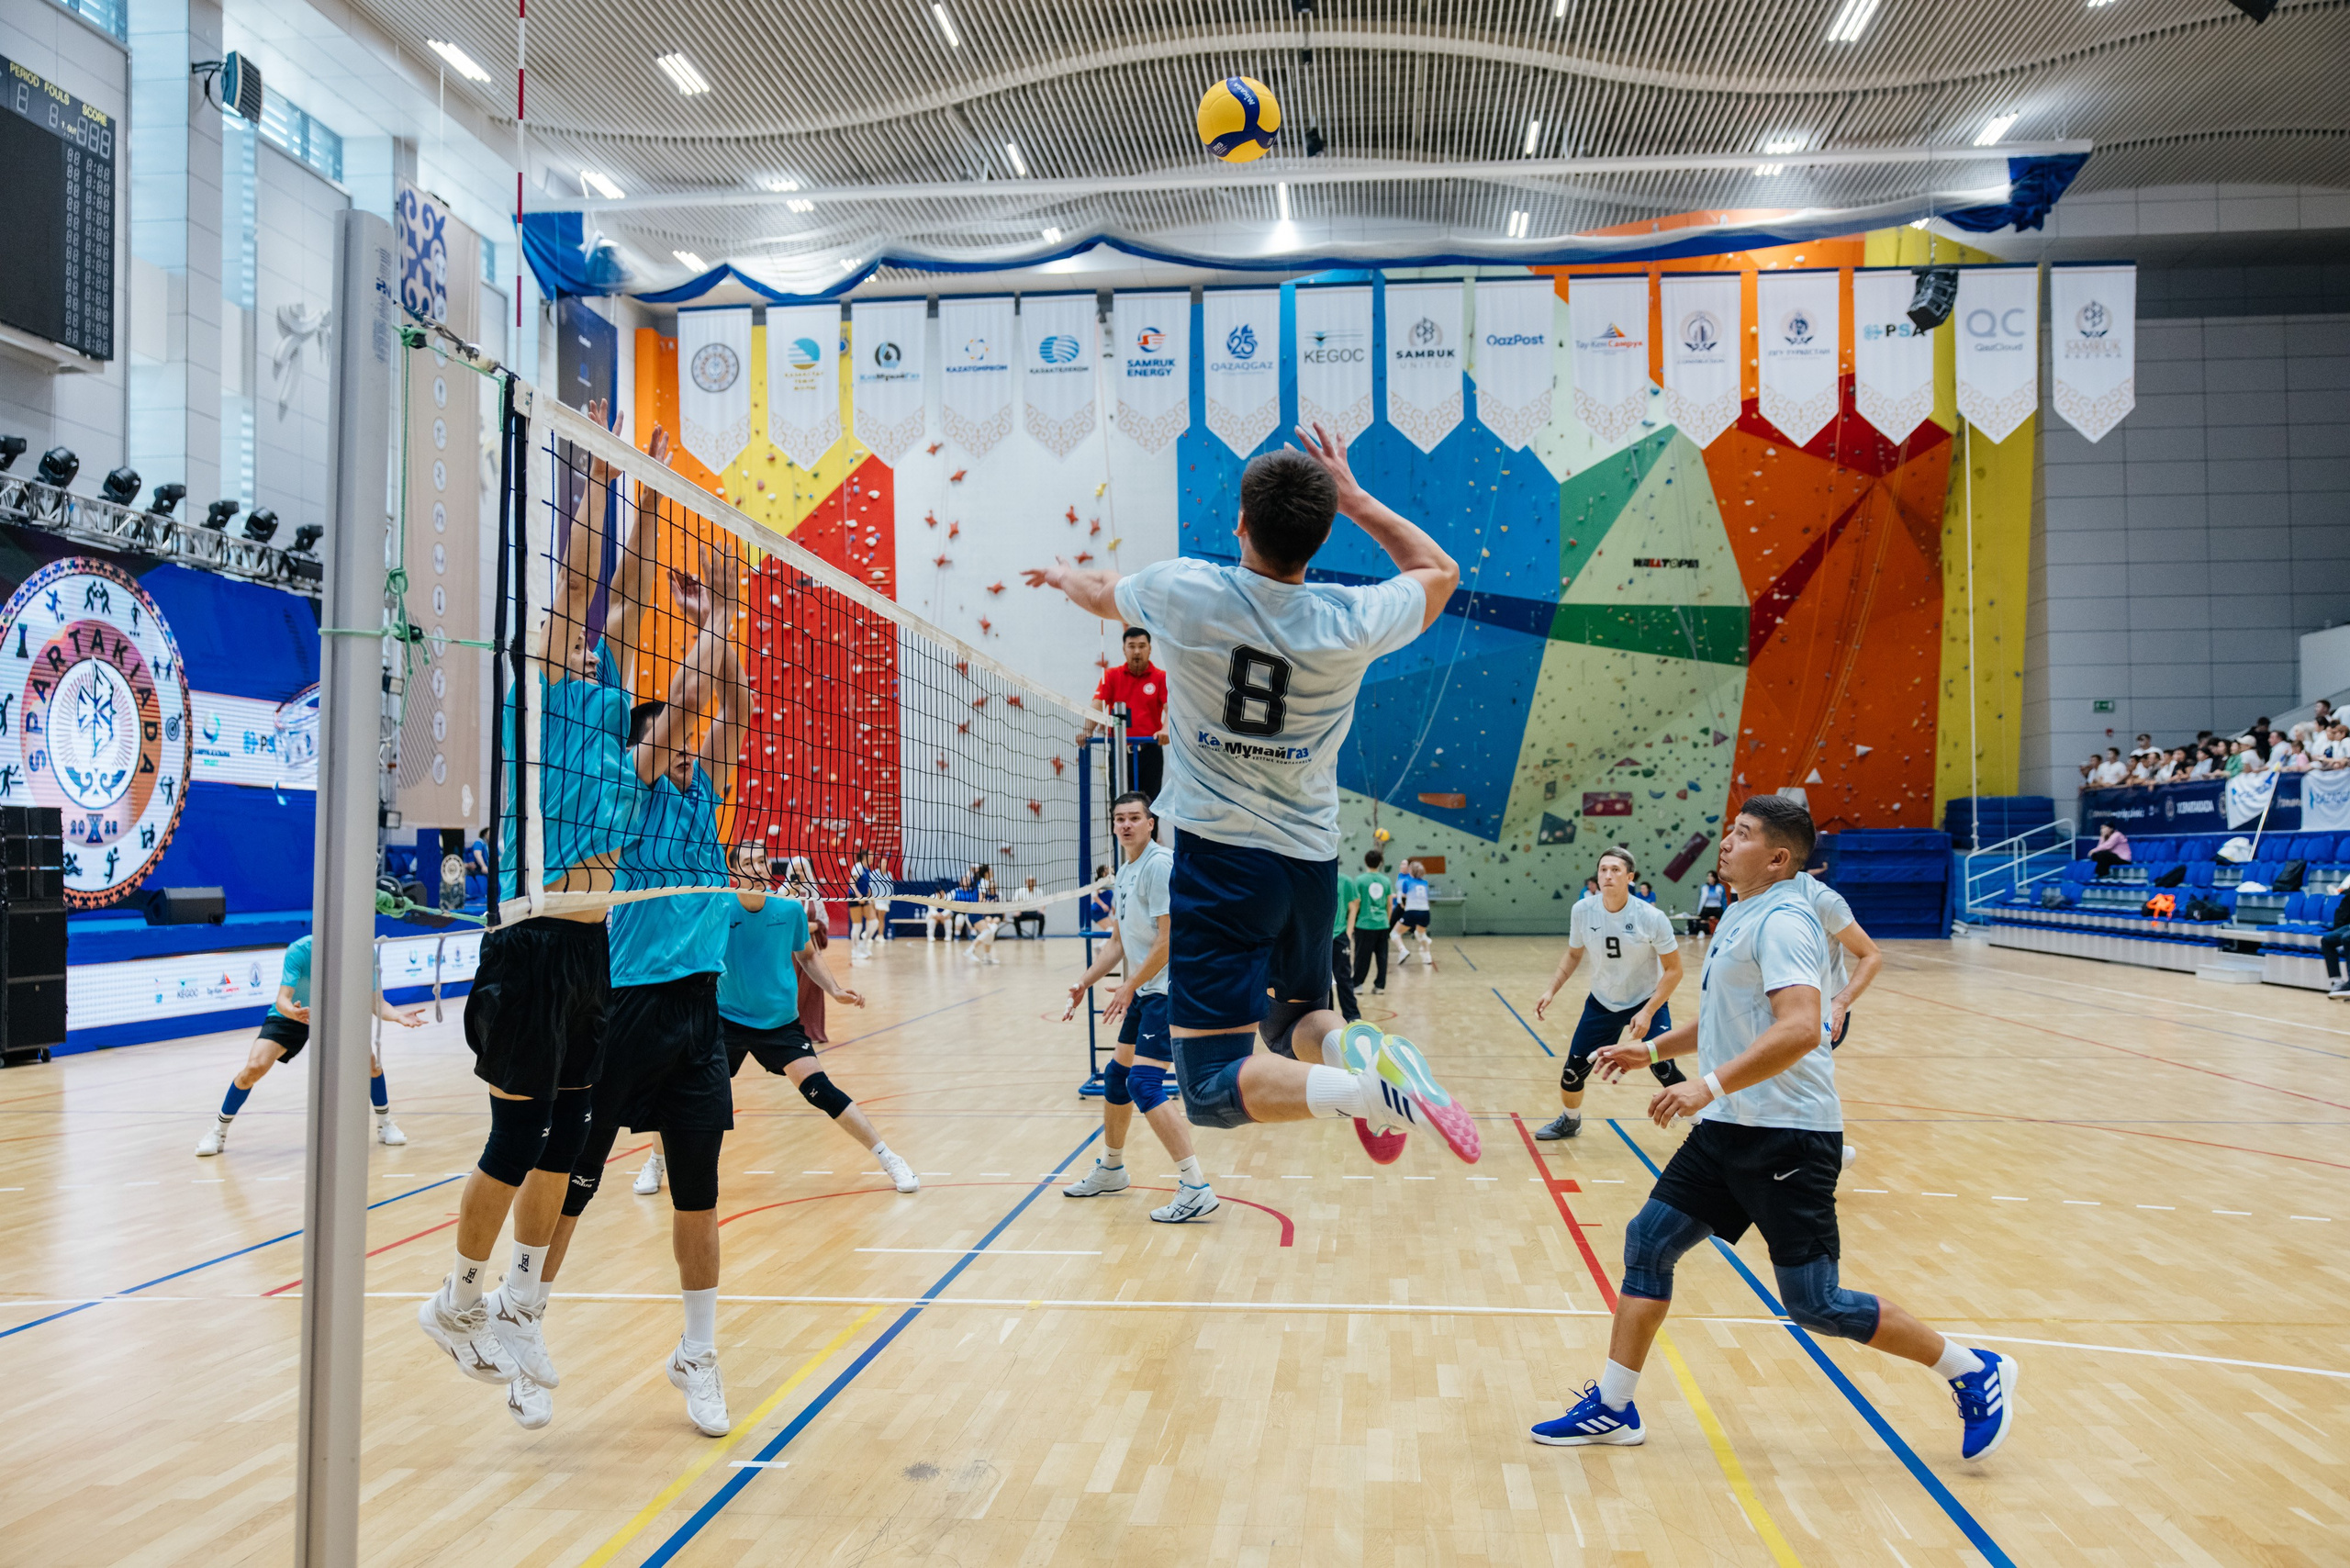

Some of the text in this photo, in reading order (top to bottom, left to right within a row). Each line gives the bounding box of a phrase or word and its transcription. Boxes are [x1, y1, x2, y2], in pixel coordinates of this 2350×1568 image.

[10, 62, 107, 127] PERIOD FOULS SCORE
[1966, 308, 2025, 337] QC
[1304, 348, 1364, 364] KEGOC
[1396, 349, 1455, 359] SAMRUK
[1127, 359, 1176, 368] SAMRUK
[1211, 361, 1274, 372] QAZAQGAZ
[1400, 360, 1452, 369] UNITED
[1127, 368, 1173, 377] ENERGY
[1222, 644, 1292, 738] 8
[26, 628, 158, 774] SPARTAKIADA
[1606, 936, 1622, 959] 9
